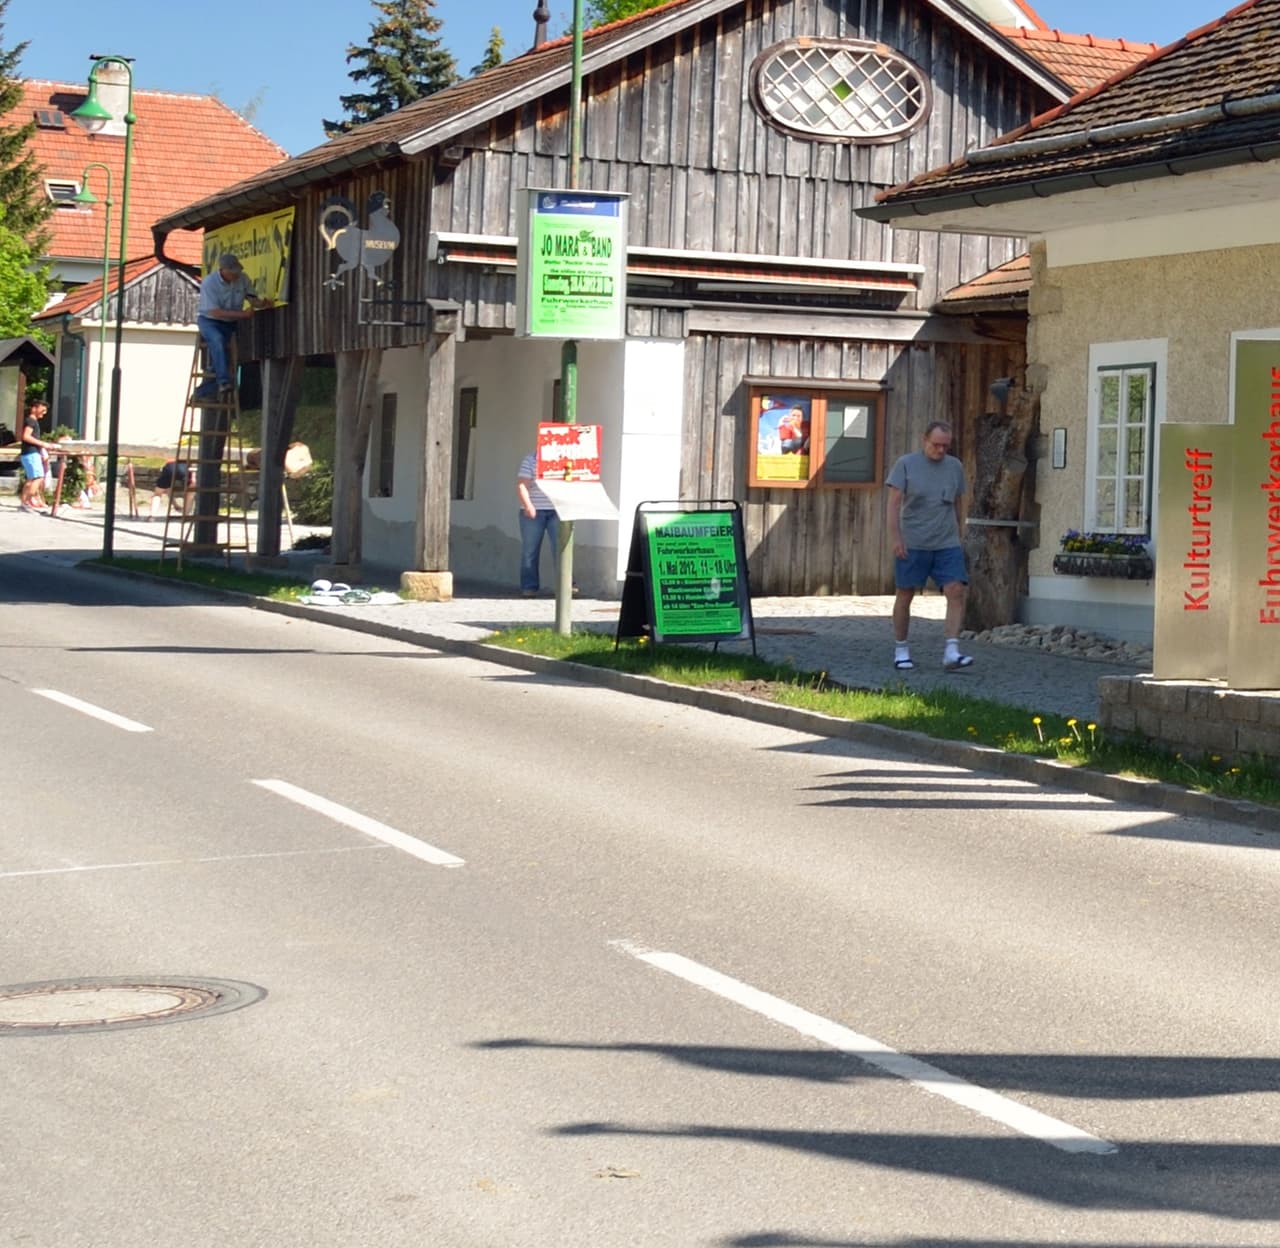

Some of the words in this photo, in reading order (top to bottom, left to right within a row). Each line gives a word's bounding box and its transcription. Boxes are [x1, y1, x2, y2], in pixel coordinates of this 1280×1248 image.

[365, 240, 395, 250] MUSEUM
[541, 234, 552, 257] JO
[555, 235, 579, 257] MARA
[591, 236, 613, 259] BAND
[655, 525, 734, 538] MAIBAUMFEIER
[1184, 448, 1213, 611] Kulturtreff
[666, 561, 678, 575] Mai
[725, 560, 737, 574] Uhr
